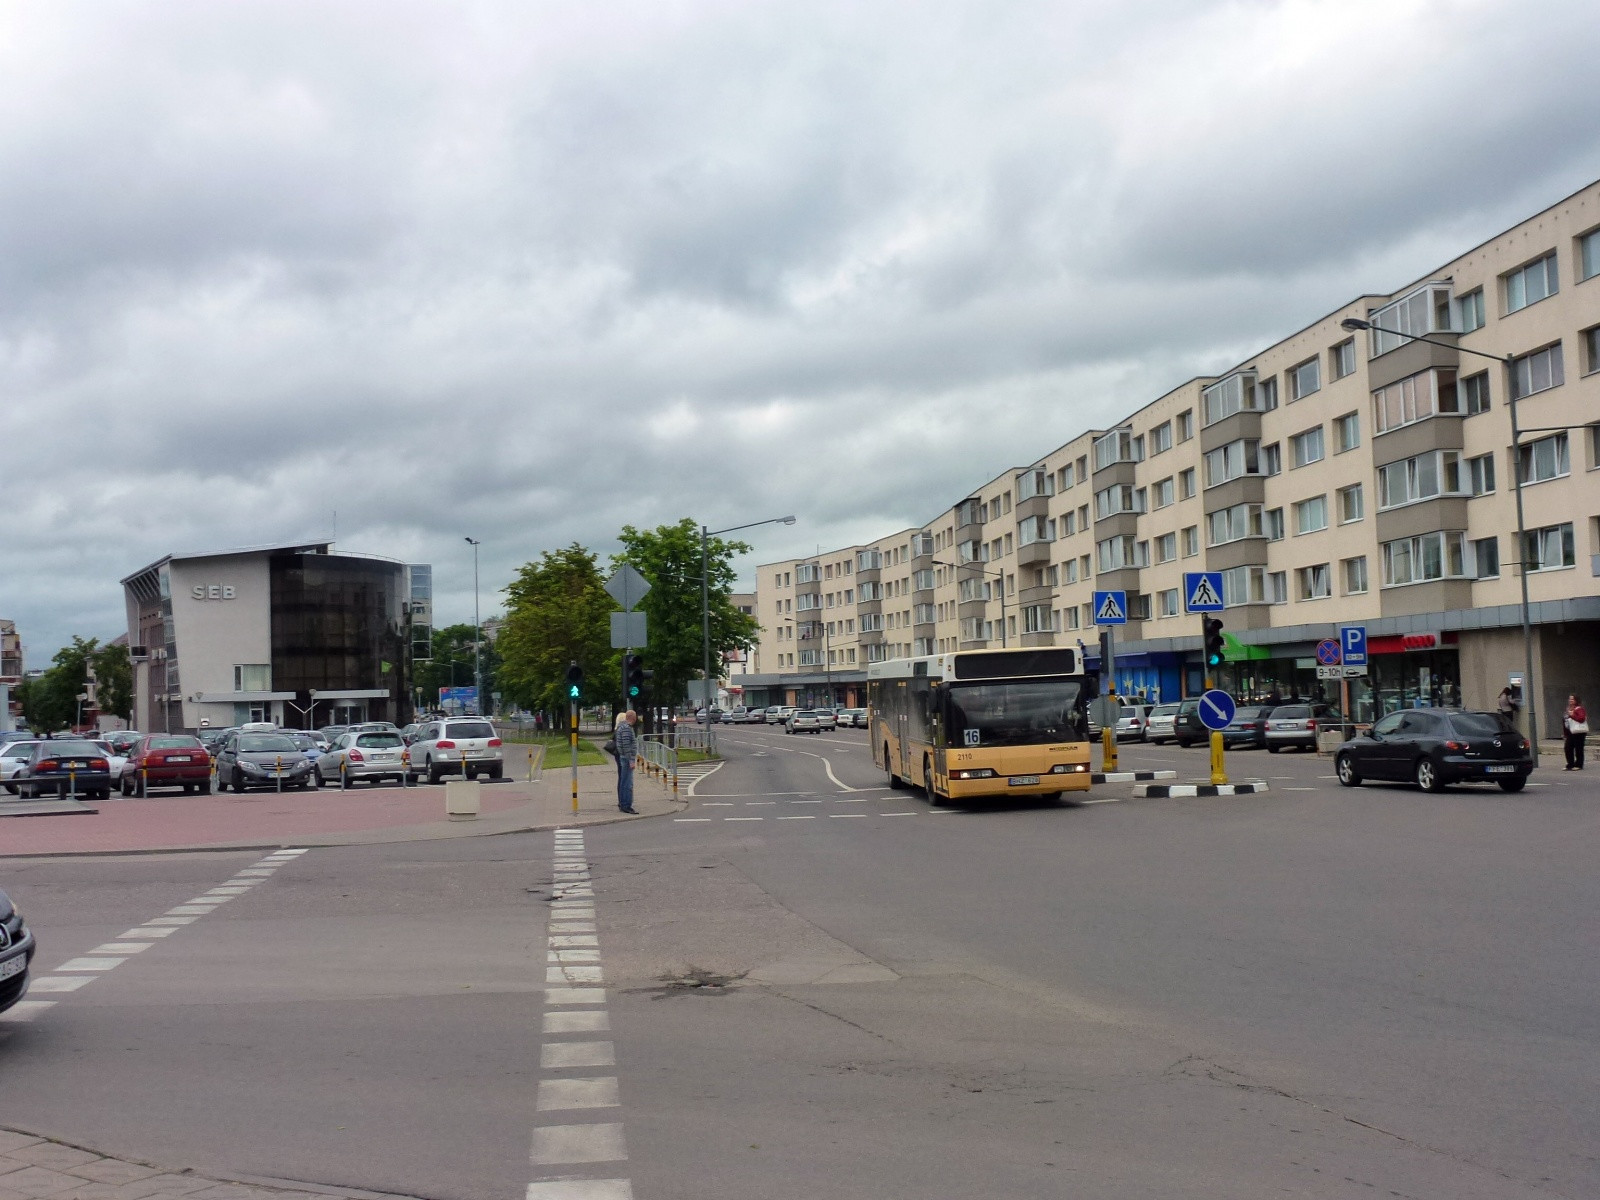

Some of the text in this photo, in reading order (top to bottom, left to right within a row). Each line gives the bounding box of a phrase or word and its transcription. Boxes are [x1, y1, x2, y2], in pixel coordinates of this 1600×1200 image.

[192, 585, 237, 600] SEB
[1347, 629, 1362, 650] P
[1319, 667, 1341, 677] 9-10h
[965, 730, 979, 743] 16
[957, 753, 973, 761] 2110
